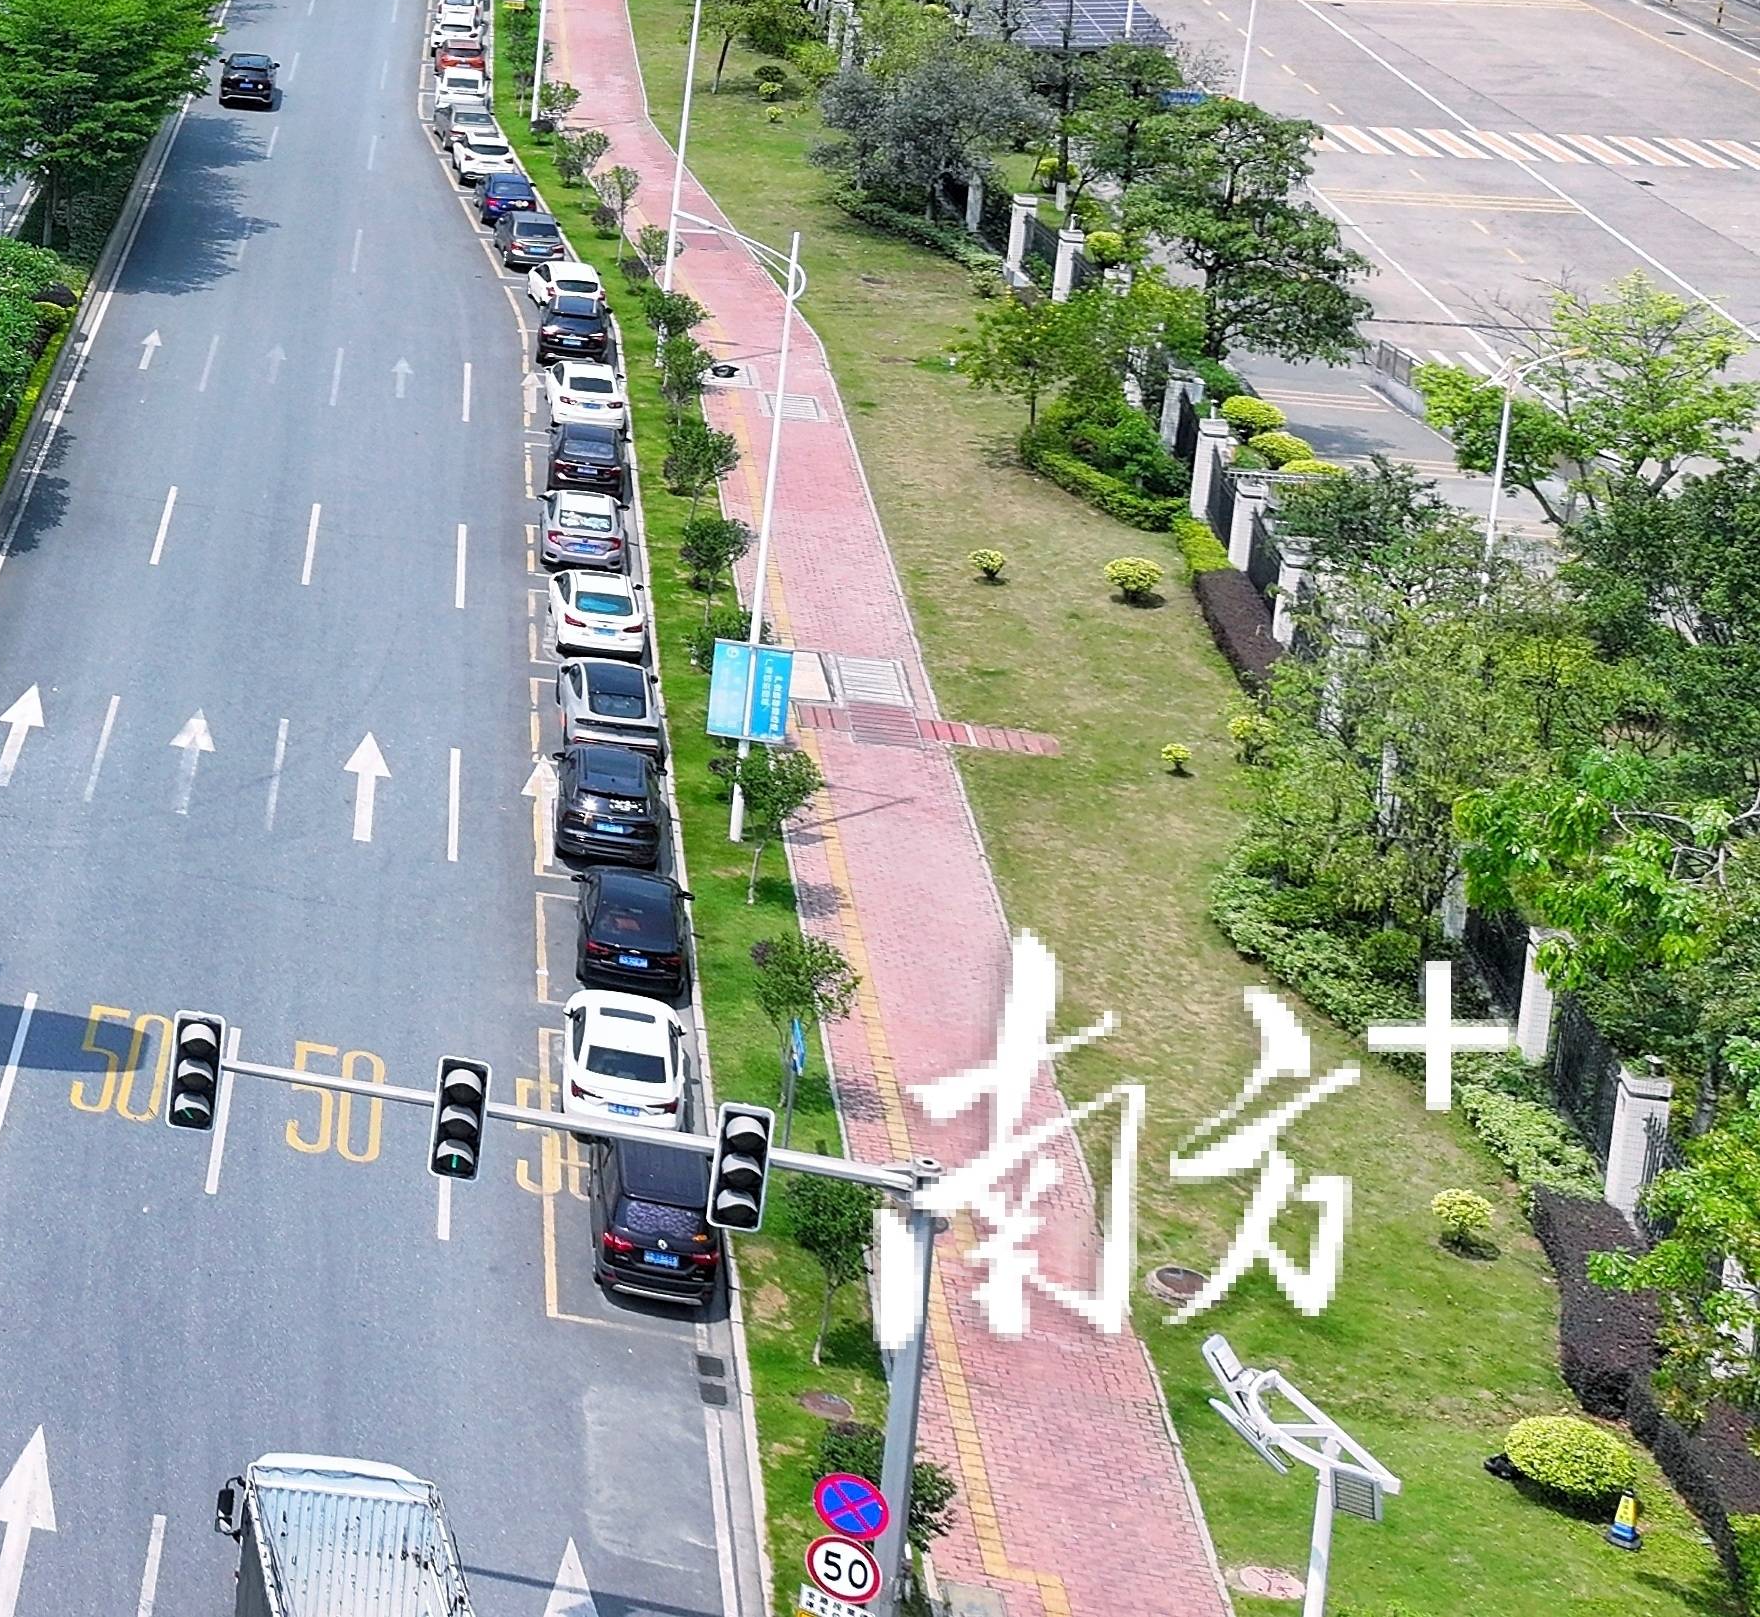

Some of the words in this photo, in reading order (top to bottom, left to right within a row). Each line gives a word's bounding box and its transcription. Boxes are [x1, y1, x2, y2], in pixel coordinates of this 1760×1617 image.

[69, 1002, 173, 1123] 50
[284, 1038, 387, 1164] 50
[823, 1549, 868, 1590] 50
